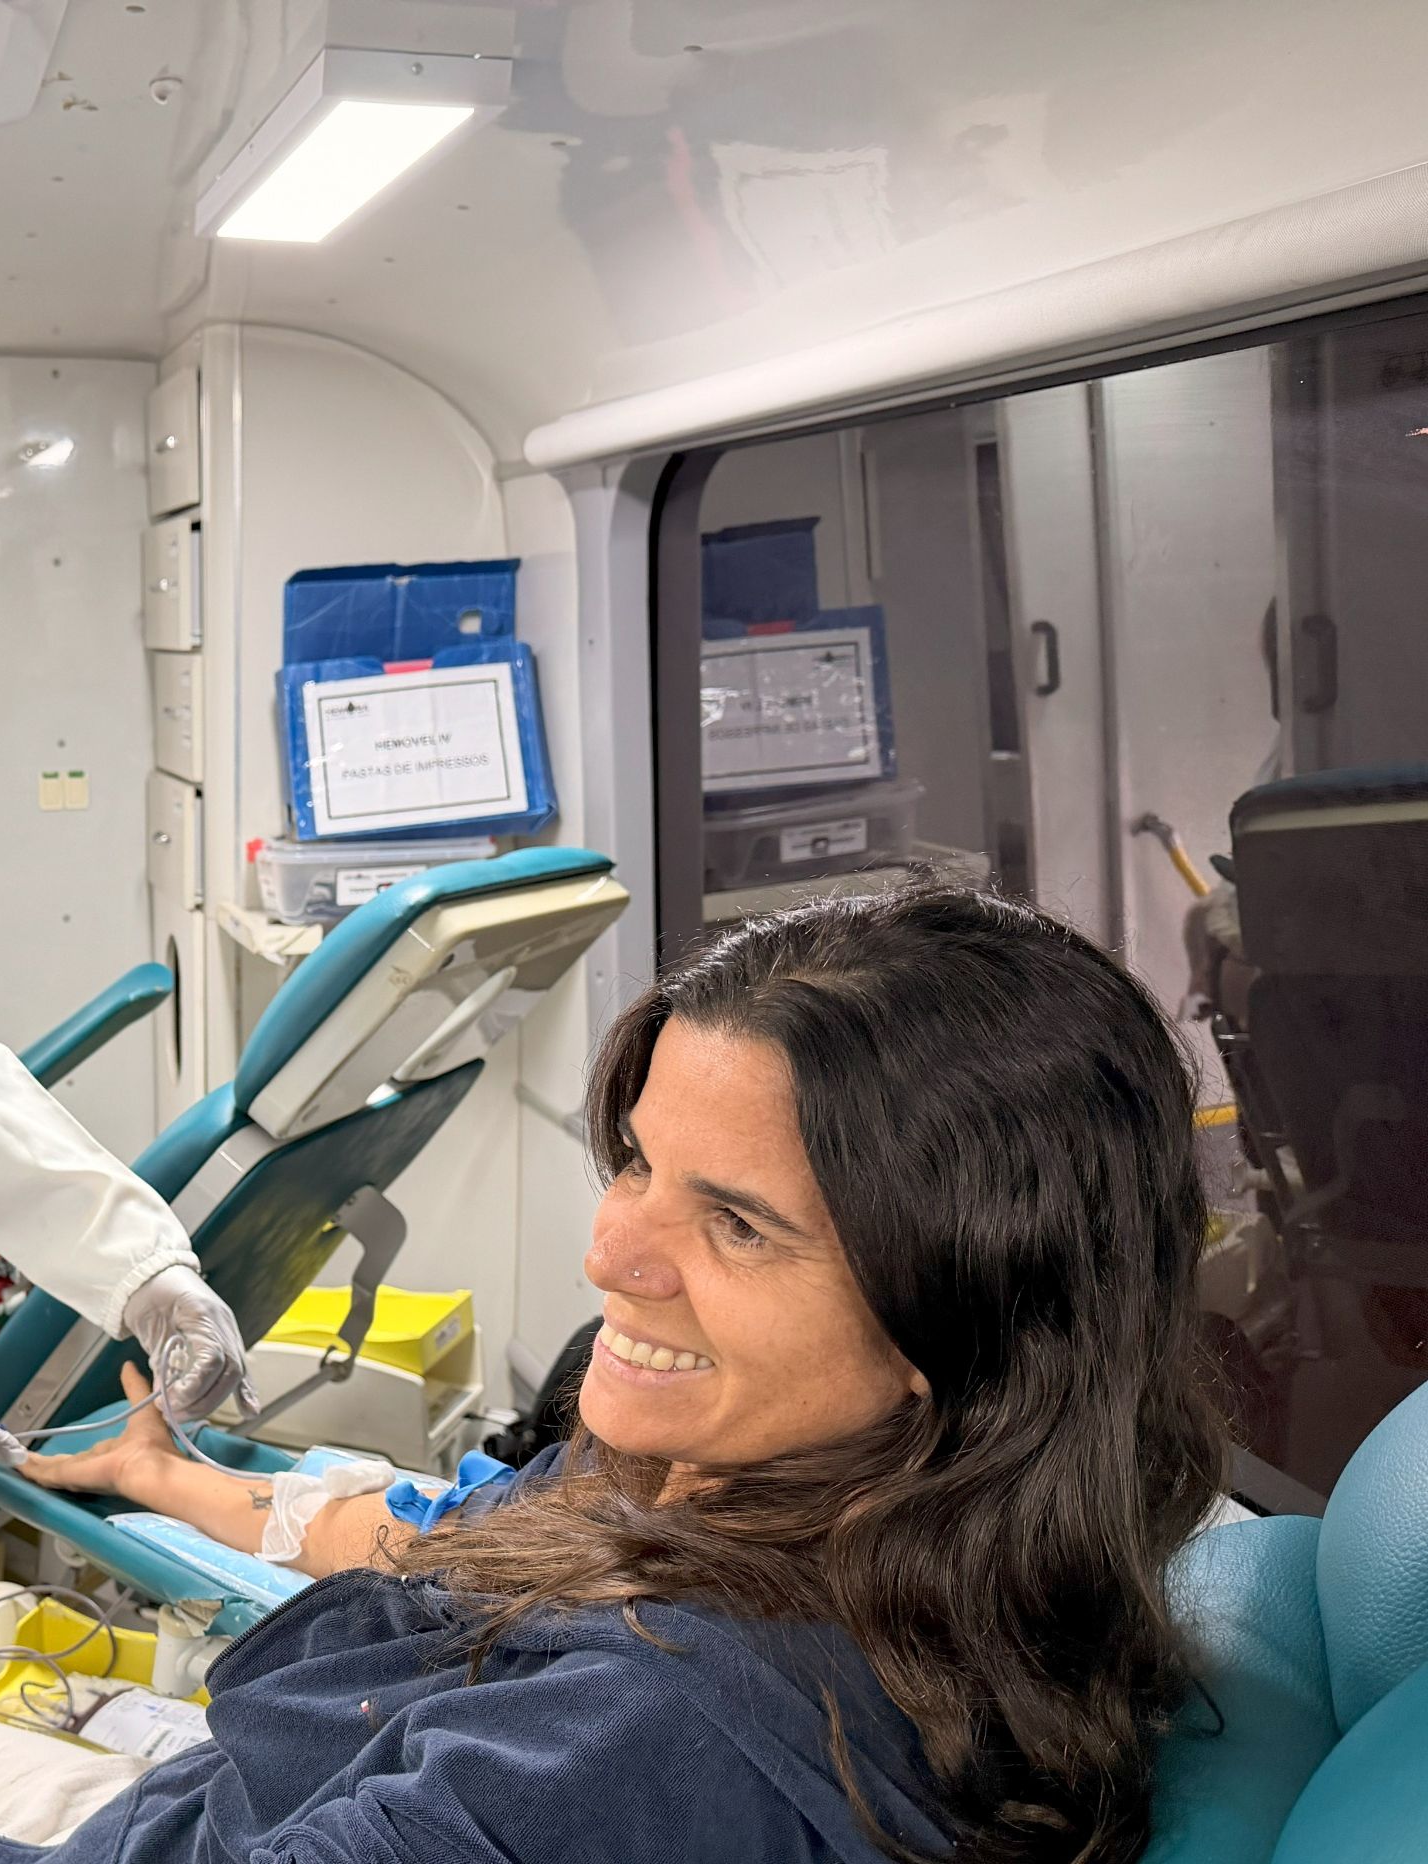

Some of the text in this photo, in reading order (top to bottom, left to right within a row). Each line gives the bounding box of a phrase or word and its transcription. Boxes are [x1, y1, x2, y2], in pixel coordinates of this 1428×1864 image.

[342, 755, 489, 780] PASTAS DE IMPRESSOS
